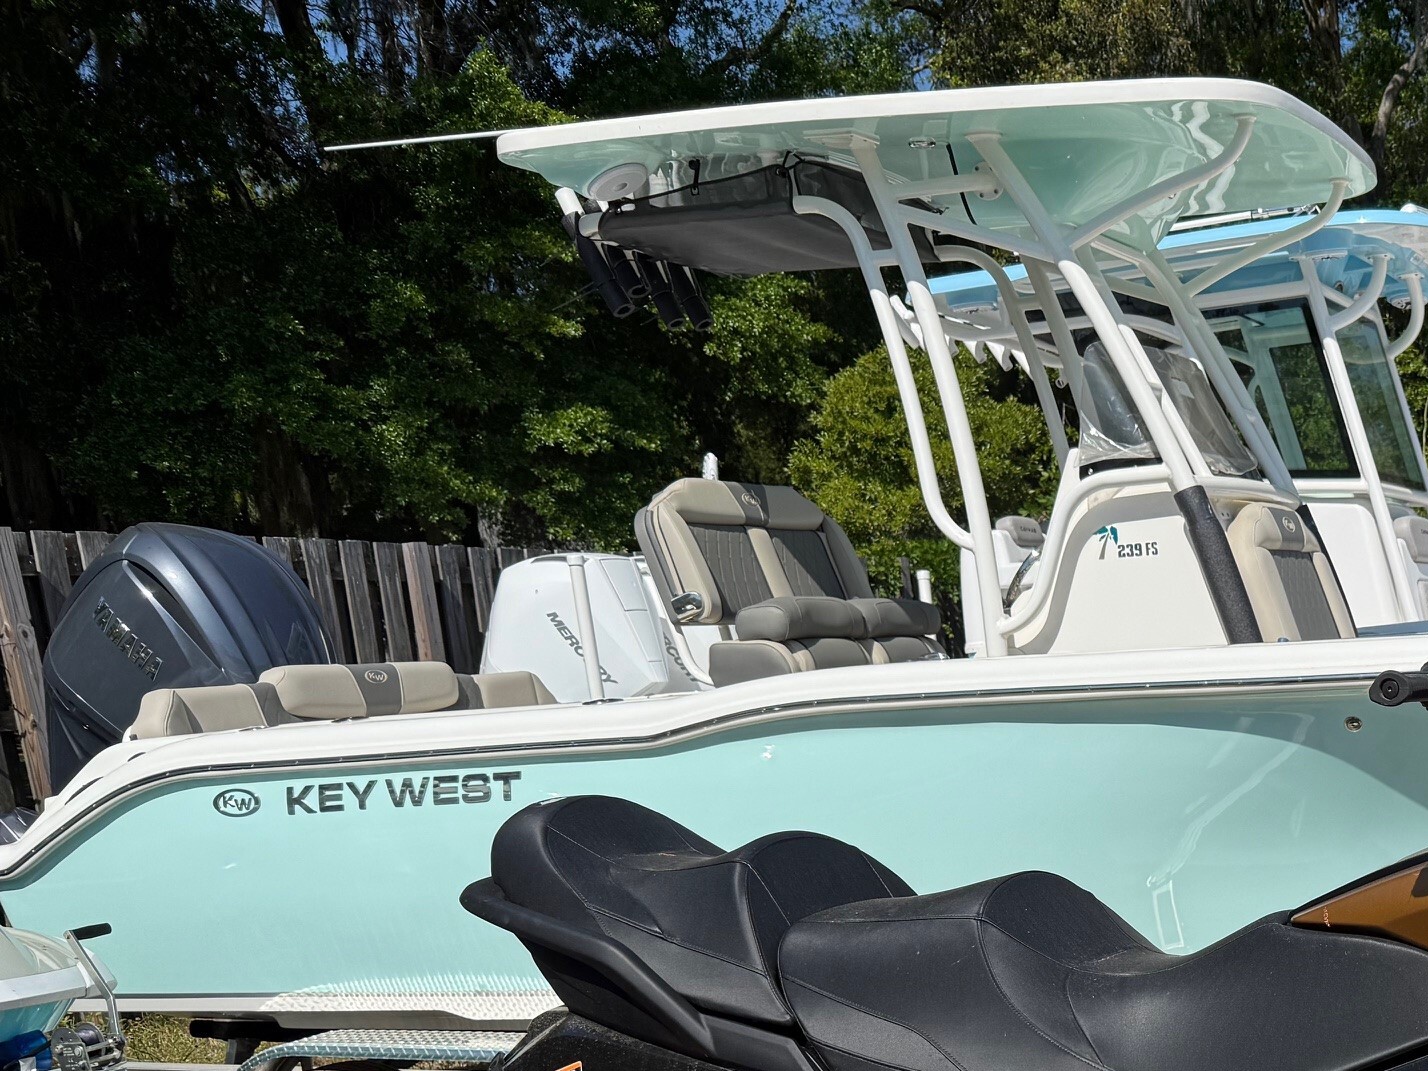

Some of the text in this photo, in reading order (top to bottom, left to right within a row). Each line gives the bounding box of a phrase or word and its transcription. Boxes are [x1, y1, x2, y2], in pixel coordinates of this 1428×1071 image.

[1117, 542, 1159, 558] 239 FS
[93, 596, 163, 681] YAMAHA
[547, 611, 618, 684] MERCRY
[286, 771, 522, 816] KEY WEST
